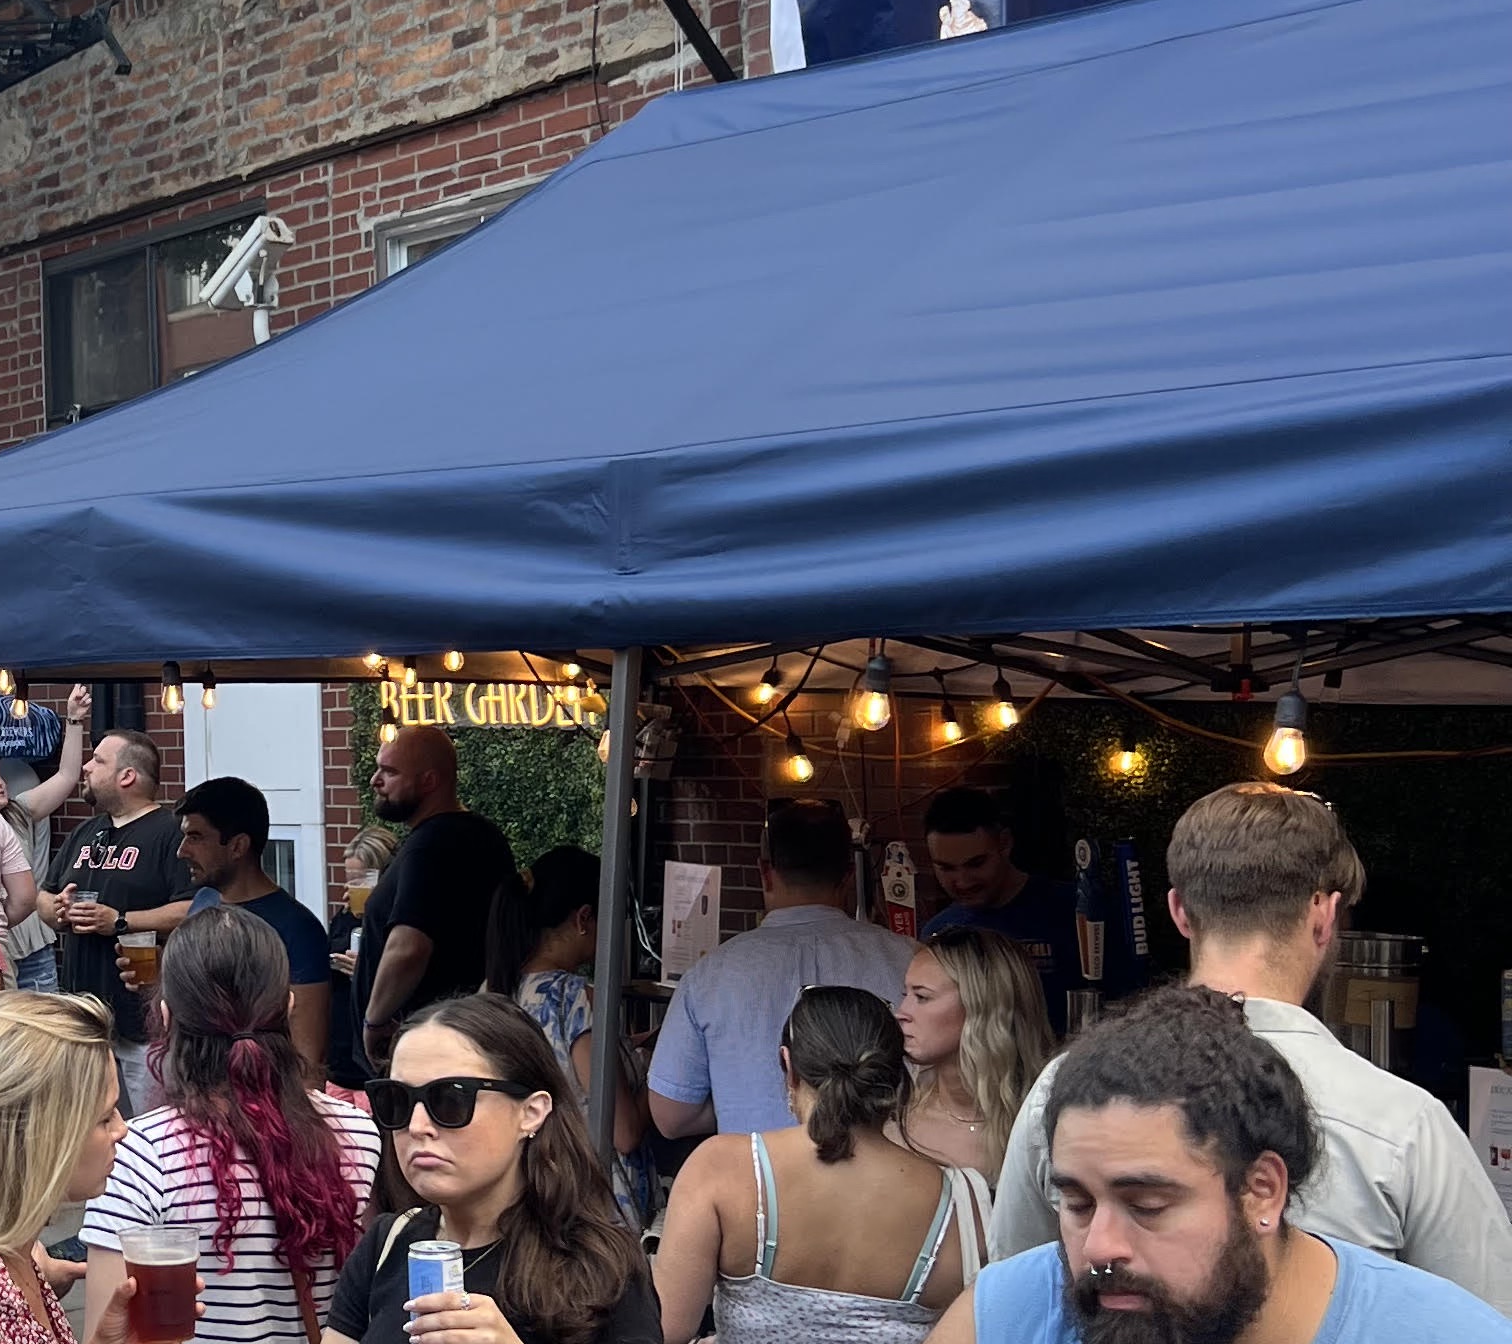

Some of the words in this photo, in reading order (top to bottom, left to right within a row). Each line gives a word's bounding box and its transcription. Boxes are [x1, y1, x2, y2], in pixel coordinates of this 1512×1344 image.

[380, 680, 456, 726] BEER
[465, 682, 597, 727] GARDEN
[73, 844, 140, 871] POLO
[1126, 859, 1145, 914] LIGHT
[1133, 915, 1149, 956] BUD
